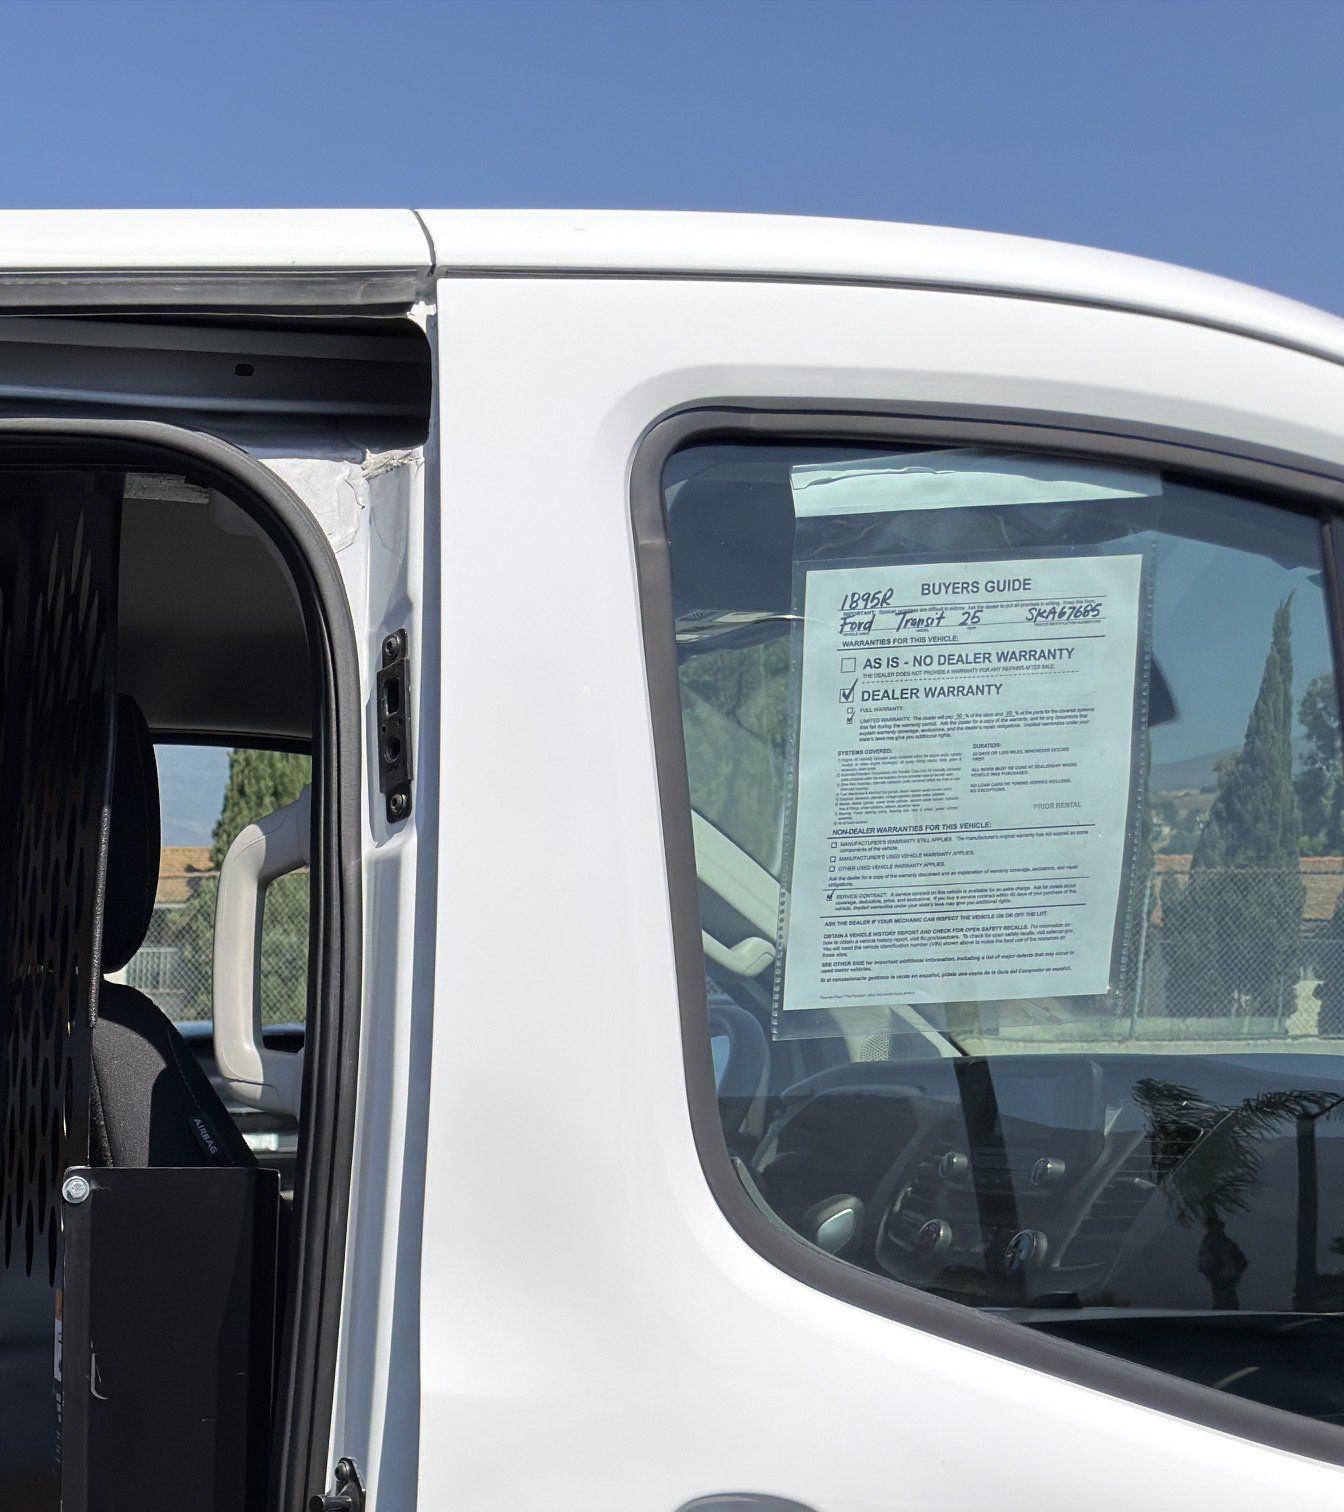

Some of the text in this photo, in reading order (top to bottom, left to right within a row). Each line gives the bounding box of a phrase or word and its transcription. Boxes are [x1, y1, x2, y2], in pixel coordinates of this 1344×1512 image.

[921, 578, 1032, 596] BUYERS GUIDE
[840, 614, 875, 634] Ford
[895, 611, 945, 632] Transit
[959, 610, 983, 626] 25
[842, 638, 891, 647] WARRANTIES
[928, 635, 959, 643] VEHICLE:
[863, 658, 882, 670] AS
[886, 656, 900, 669] IS
[913, 655, 933, 667] NO
[937, 652, 992, 666] DEALER
[996, 648, 1075, 663] WARRANTY
[861, 683, 1003, 702] DEALER WARRANTY
[1056, 801, 1081, 809] RENTAL
[833, 827, 875, 835] NON-DEALER
[876, 826, 923, 834] WARRANTIES
[193, 1119, 217, 1153] AIRBAG
